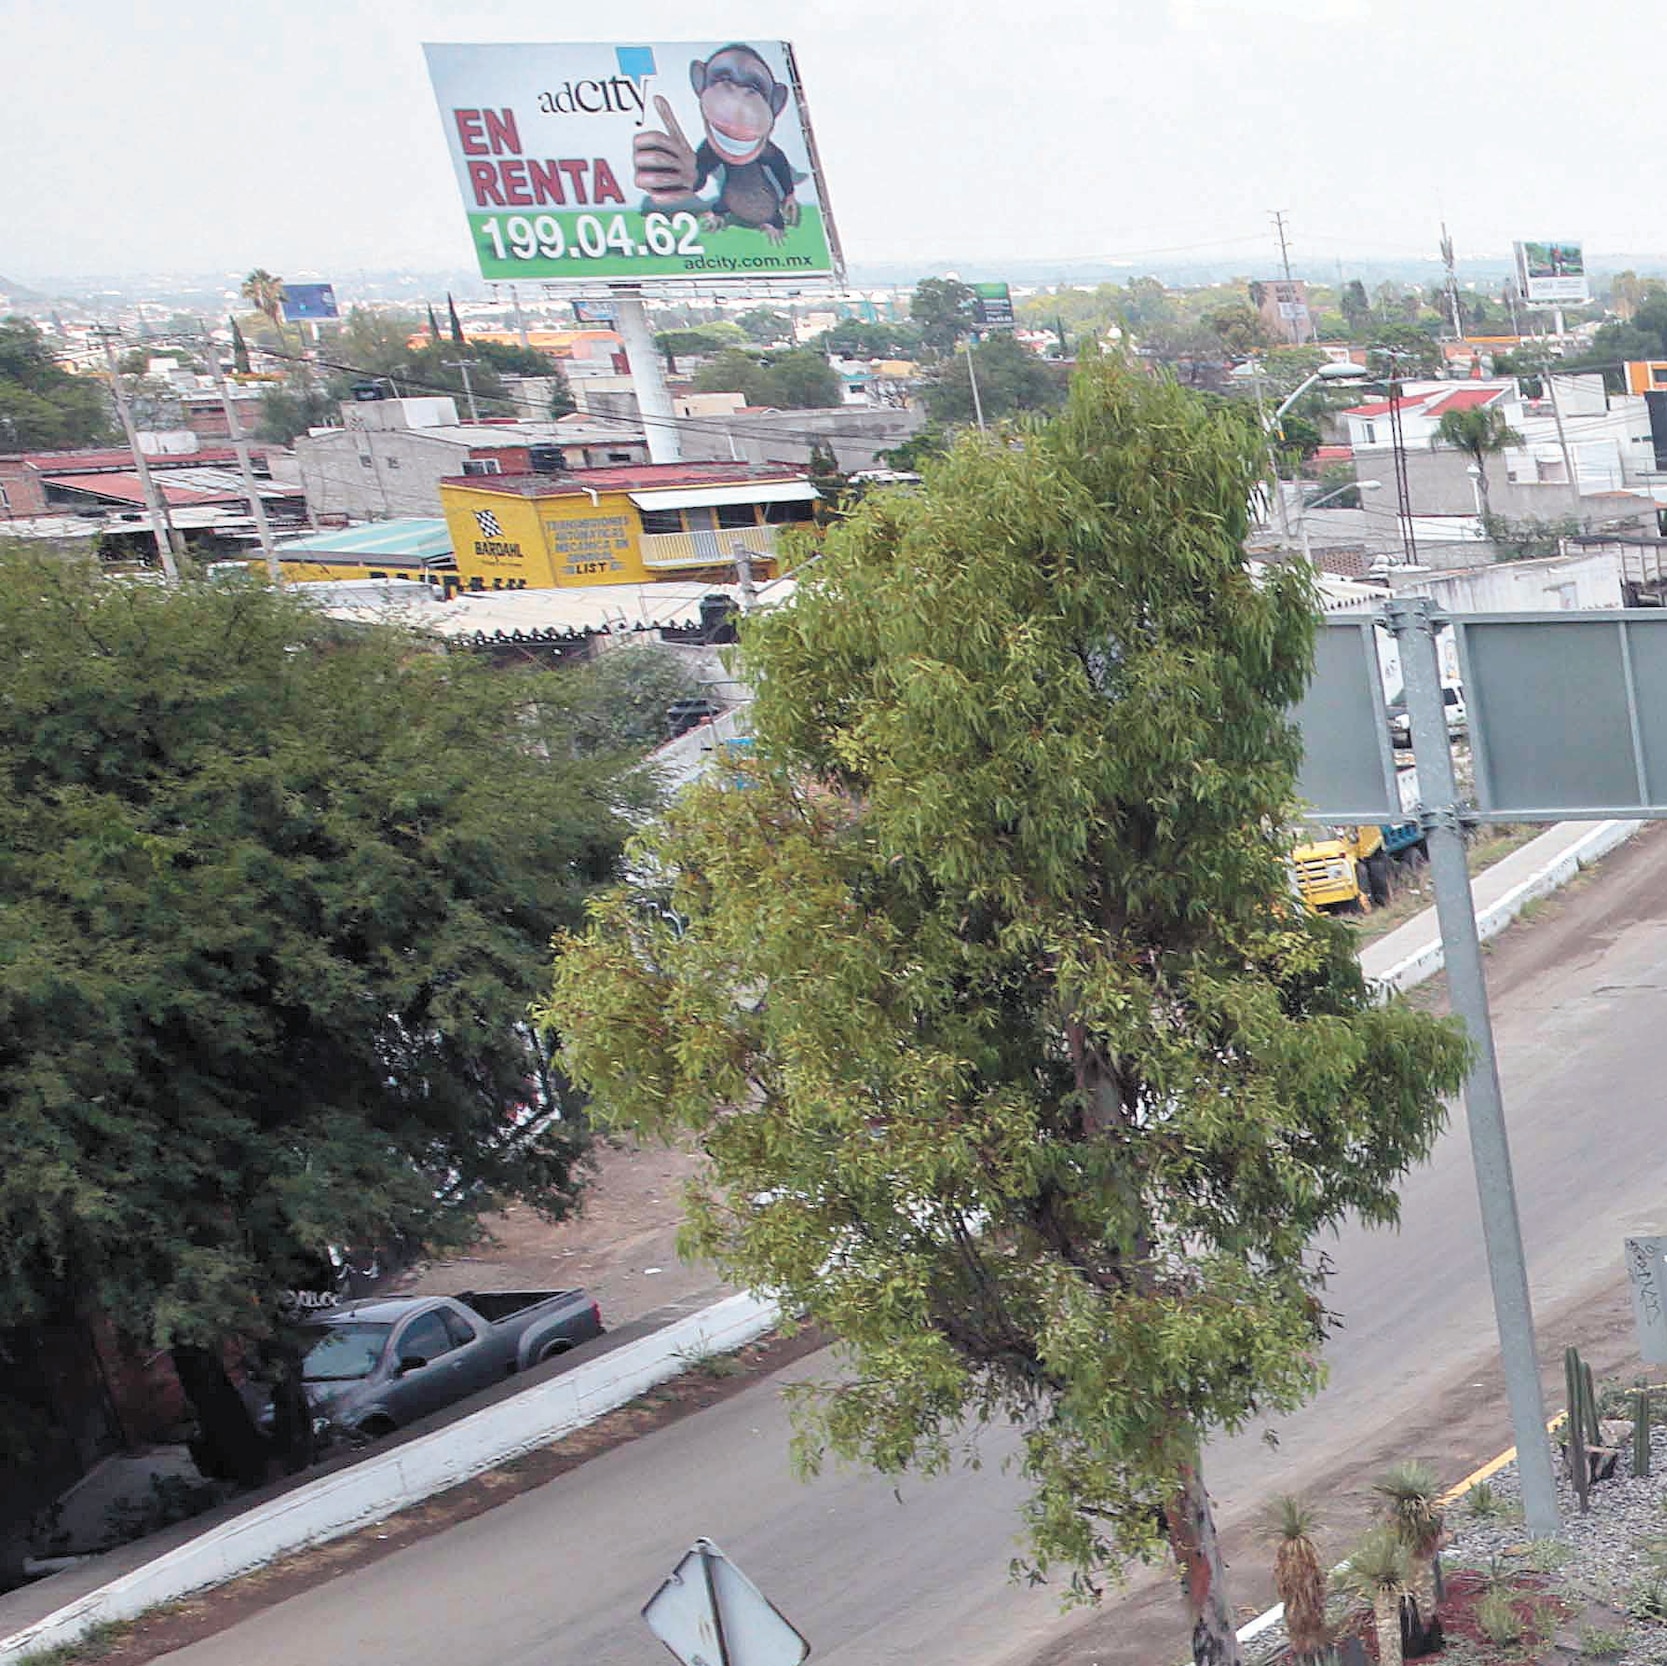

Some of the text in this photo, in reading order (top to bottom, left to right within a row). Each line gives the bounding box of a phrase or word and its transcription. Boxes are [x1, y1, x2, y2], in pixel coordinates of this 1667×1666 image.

[454, 109, 522, 156] EN
[468, 158, 627, 206] RENTA
[482, 211, 704, 260] 199.04.62
[684, 252, 813, 271] adcity.com.mx
[576, 562, 607, 574] LIST
